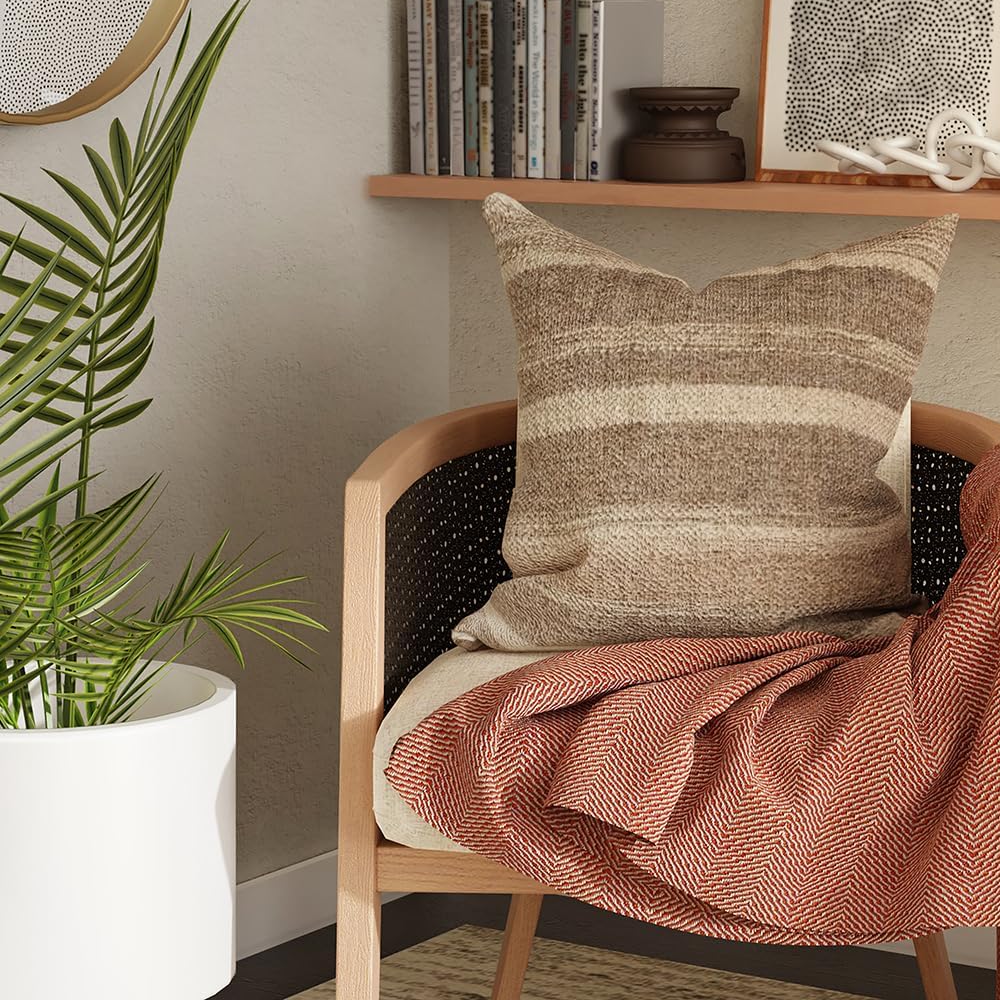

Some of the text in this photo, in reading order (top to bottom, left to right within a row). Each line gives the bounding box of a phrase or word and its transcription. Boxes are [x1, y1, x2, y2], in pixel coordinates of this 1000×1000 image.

[577, 33, 589, 123] Into the Light
